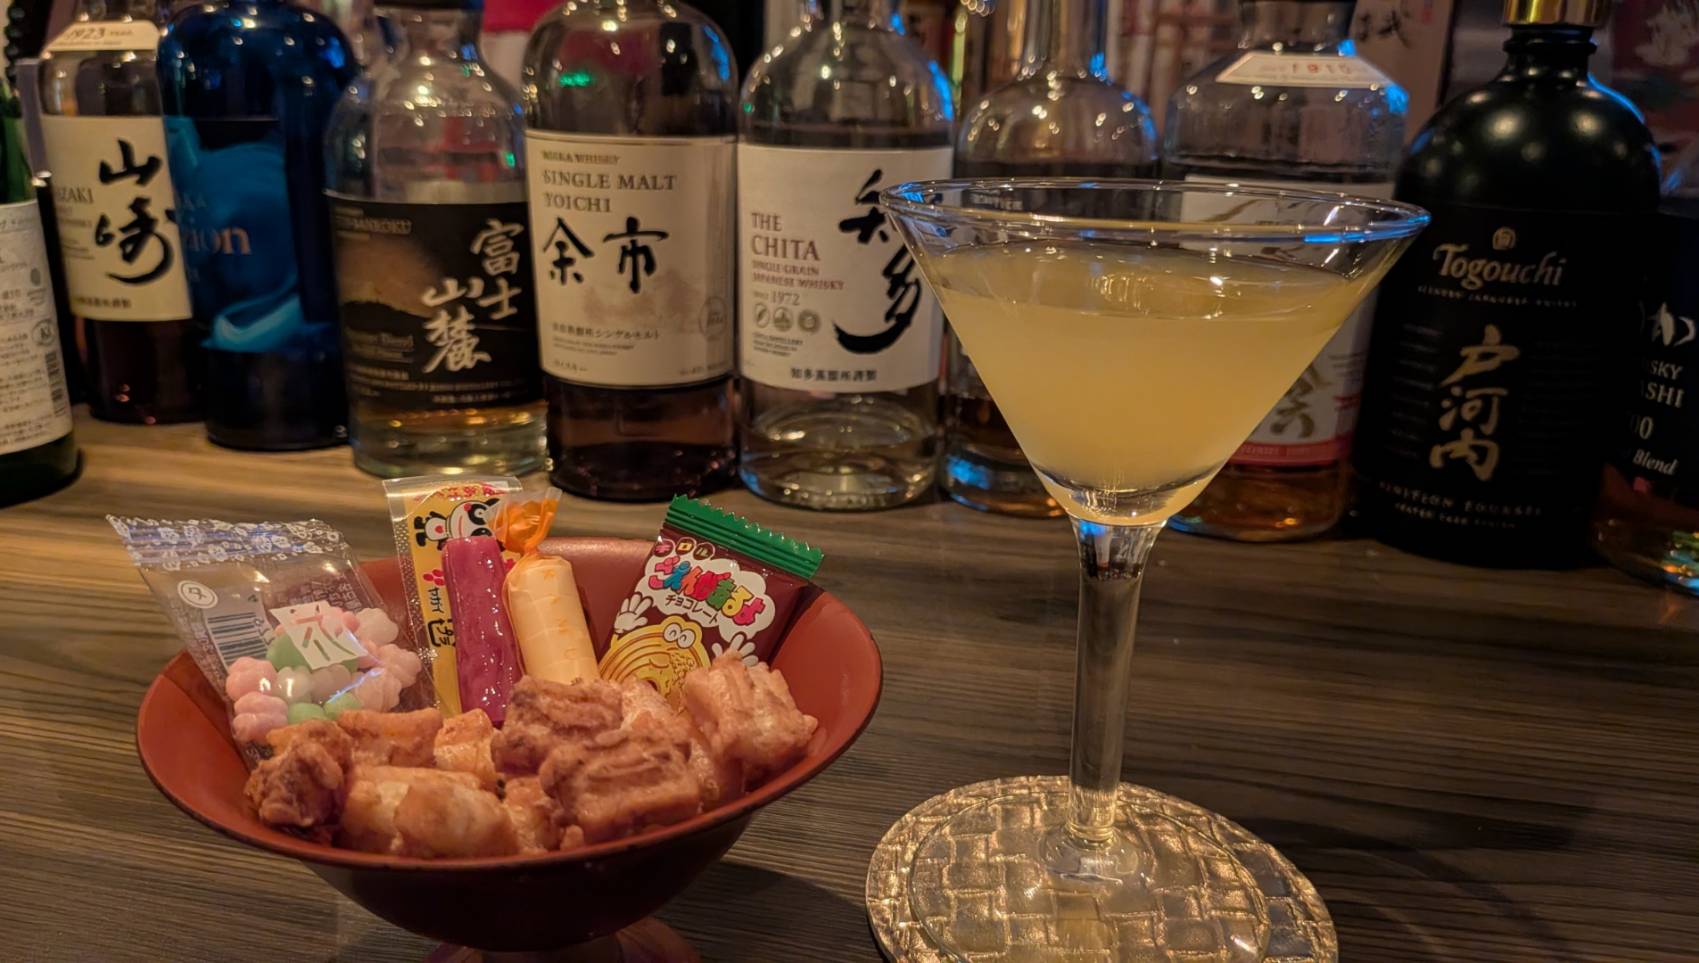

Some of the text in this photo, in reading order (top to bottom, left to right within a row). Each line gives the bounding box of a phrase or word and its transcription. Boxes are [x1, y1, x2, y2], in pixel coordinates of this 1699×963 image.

[543, 170, 677, 191] SINGLE MALT
[543, 192, 612, 213] YOICHI
[752, 212, 782, 232] THE
[543, 216, 669, 293] 余市
[752, 234, 821, 261] CHITA
[470, 218, 524, 320] 富士
[784, 264, 819, 276] GRAIN
[1432, 242, 1568, 290] Togouchi
[797, 279, 844, 291] WHISKY
[771, 292, 800, 306] 1972
[421, 277, 492, 374] 山麓
[1645, 358, 1684, 381] SKY
[1644, 381, 1687, 408] SHI
[665, 593, 719, 625] チョコレート
